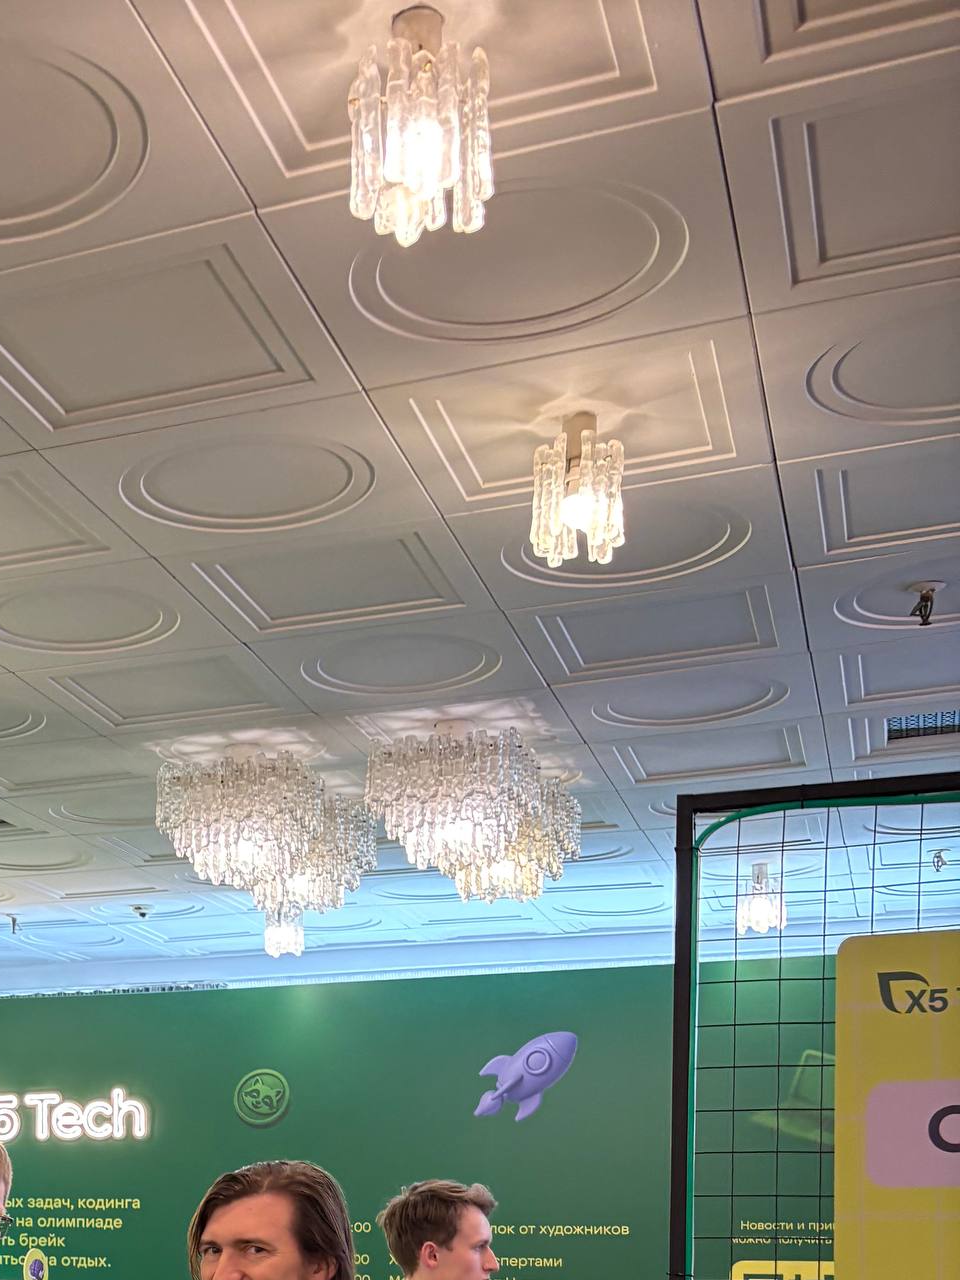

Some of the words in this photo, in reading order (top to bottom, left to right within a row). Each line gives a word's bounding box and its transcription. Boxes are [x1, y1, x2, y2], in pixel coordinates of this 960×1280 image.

[905, 988, 949, 1013] X5
[24, 1087, 146, 1140] Tech
[27, 1198, 74, 1210] задач,
[77, 1198, 141, 1210] кодинга
[16, 1217, 33, 1228] на
[37, 1217, 123, 1230] олимпиаде
[740, 1220, 794, 1231] Новости
[797, 1222, 805, 1231] и
[519, 1224, 536, 1235] от
[539, 1224, 630, 1238] художников
[19, 1233, 66, 1249] брейк
[61, 1256, 112, 1268] отдых.
